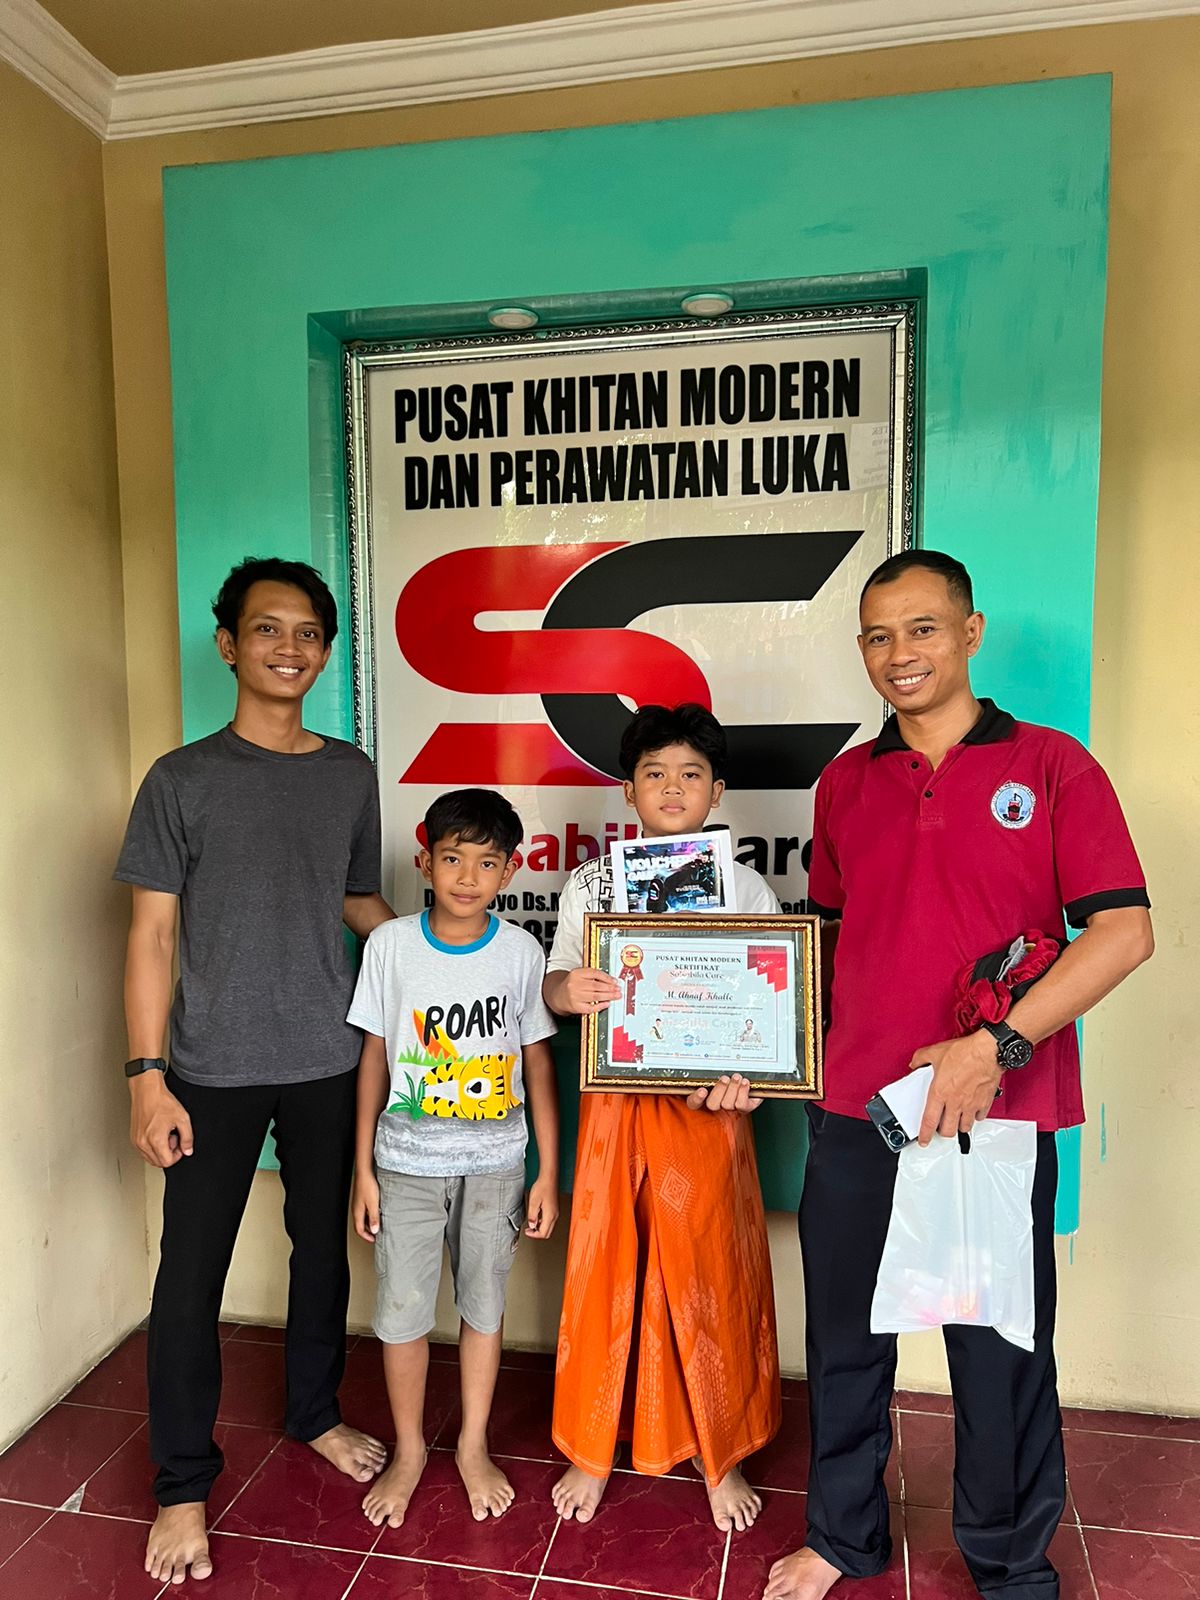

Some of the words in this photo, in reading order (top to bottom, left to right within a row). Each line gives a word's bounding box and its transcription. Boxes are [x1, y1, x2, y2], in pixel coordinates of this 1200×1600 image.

[394, 381, 513, 443] PUSAT
[523, 371, 670, 435] KHITAN
[680, 358, 861, 429] MODERN
[404, 453, 480, 511] DAN
[490, 438, 729, 507] PERAWATAN
[741, 433, 850, 496] LUKA
[655, 954, 678, 962] PUSAT
[710, 956, 741, 964] MODERN
[674, 964, 720, 972] SERTIFIKAT
[423, 995, 507, 1046] ROAR!
